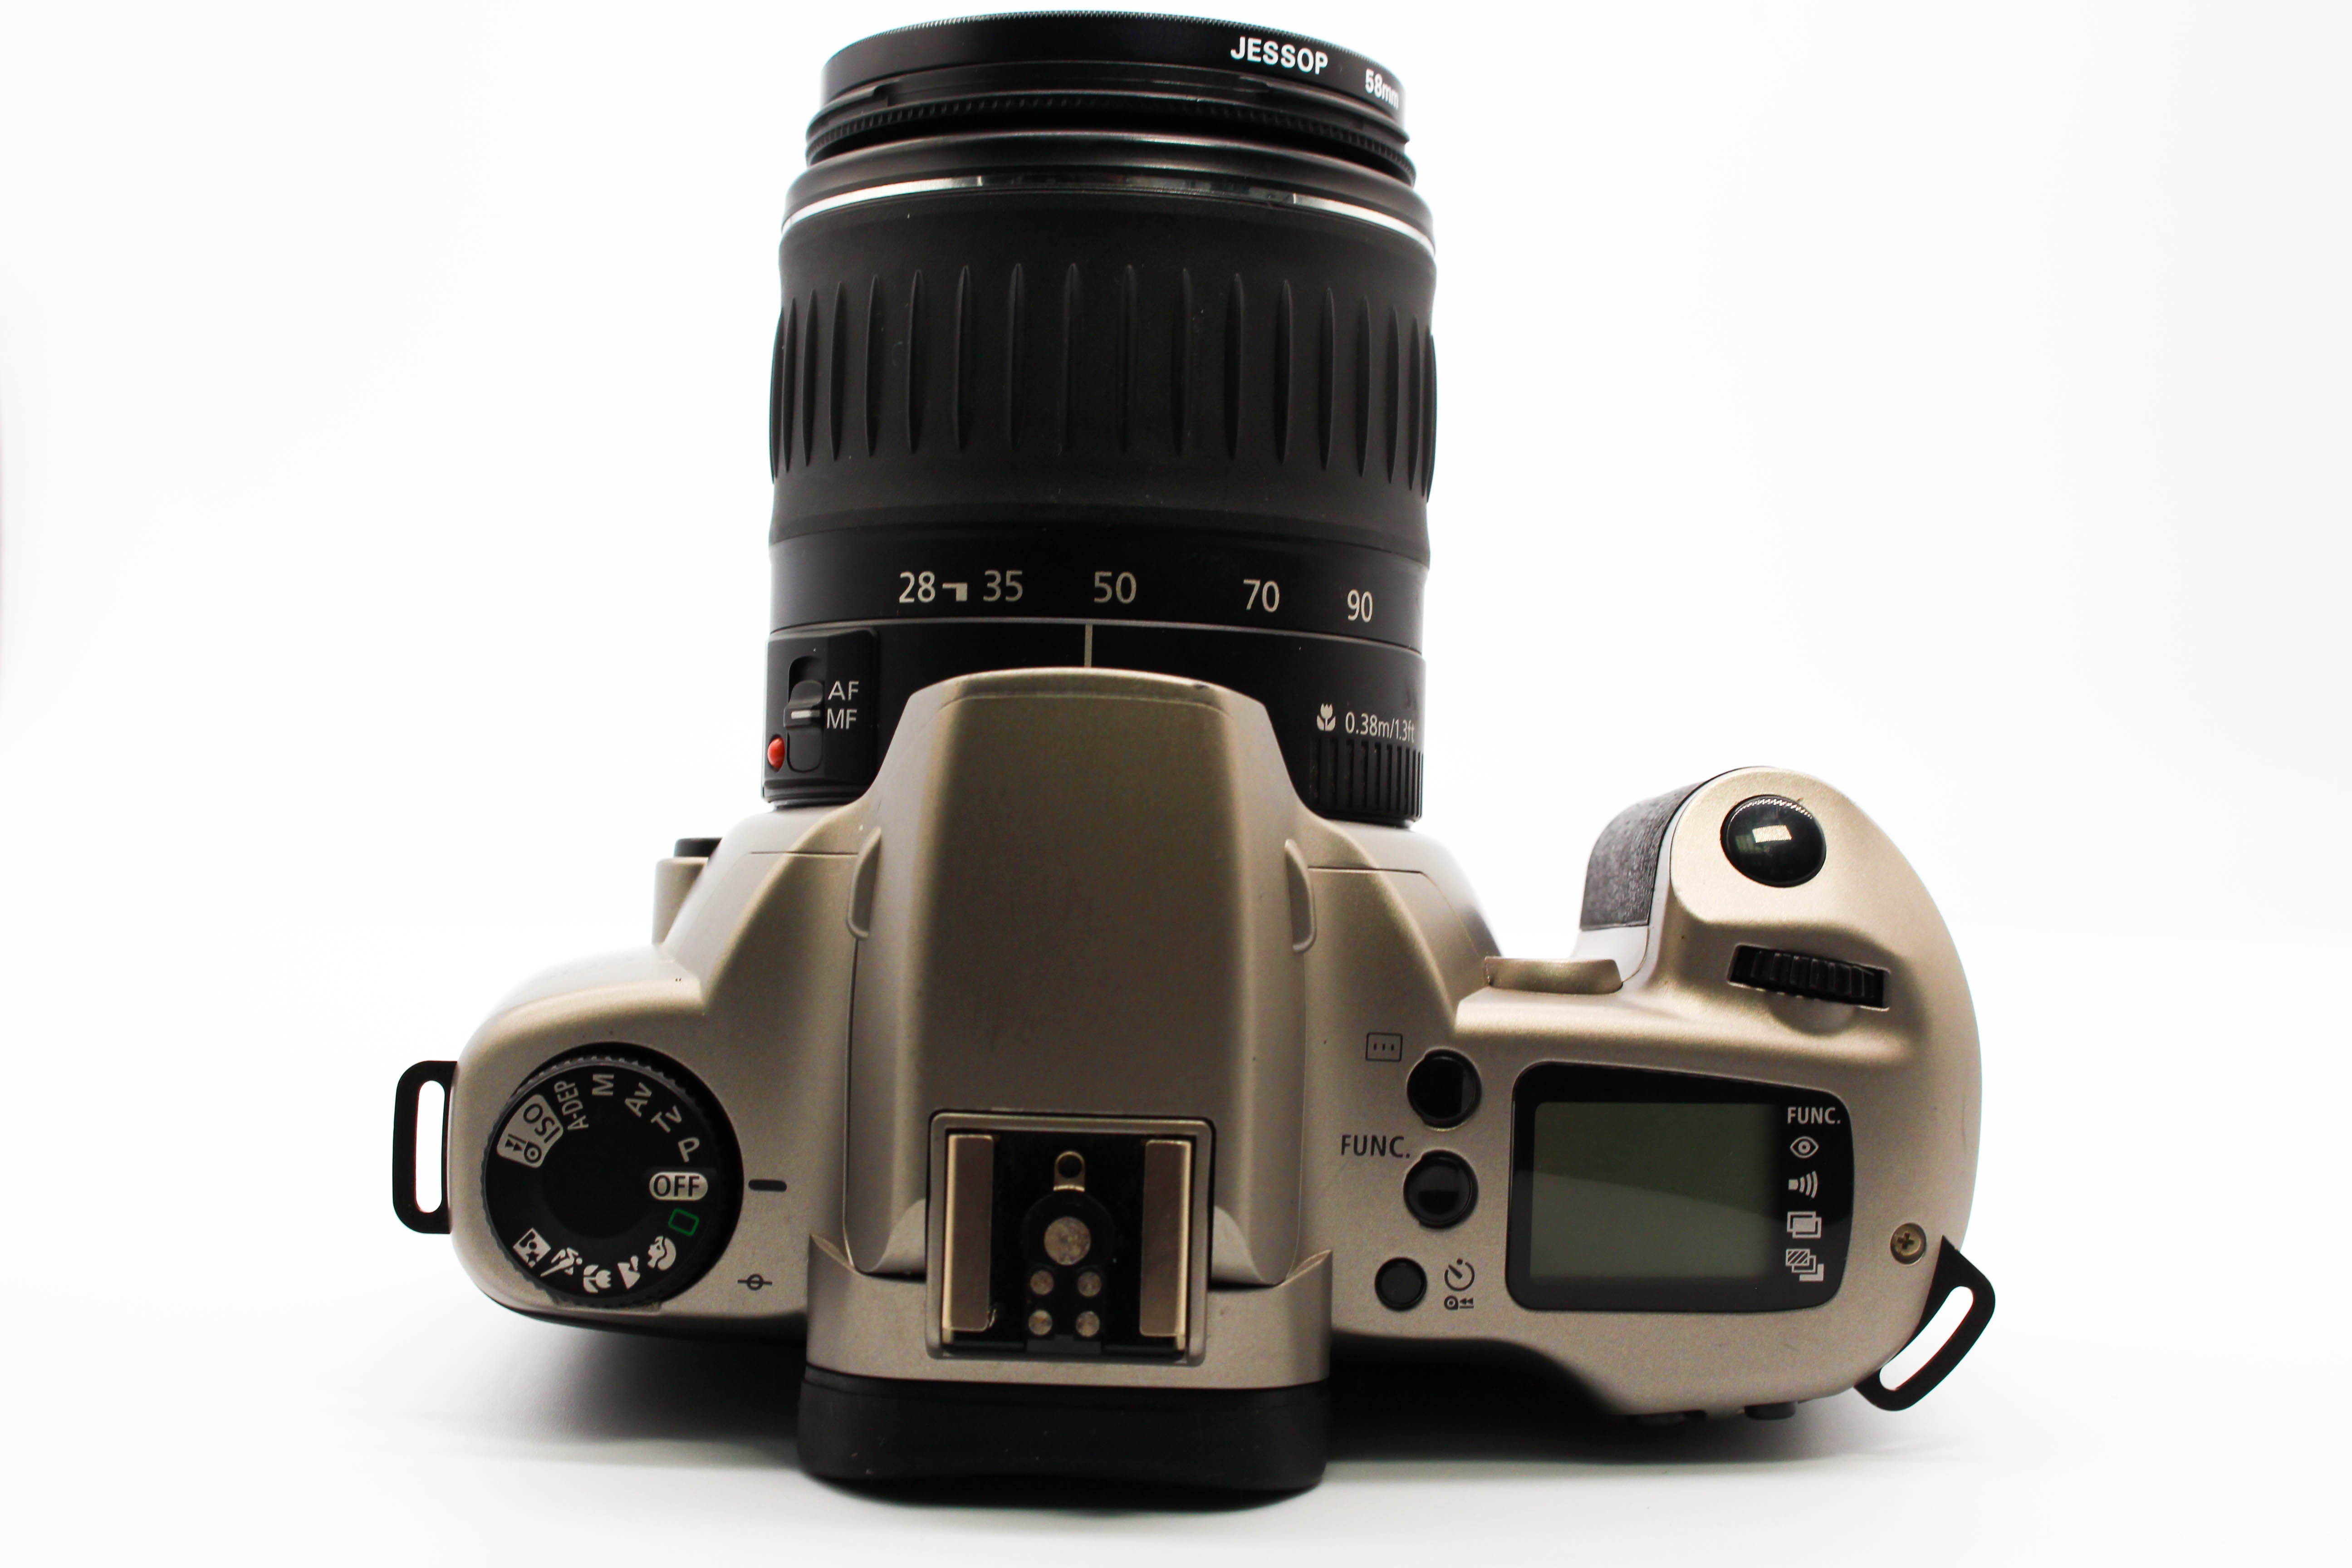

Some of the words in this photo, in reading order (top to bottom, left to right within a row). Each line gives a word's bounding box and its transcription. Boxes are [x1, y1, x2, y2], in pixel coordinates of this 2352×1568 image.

[1230, 36, 1328, 75] JESSOP
[1365, 69, 1399, 109] 58mm
[983, 570, 1023, 602] 35
[1093, 571, 1136, 604] 50
[1244, 579, 1279, 612] 70
[1347, 589, 1373, 622] 90
[828, 681, 859, 701] AF
[826, 708, 857, 730] MF
[592, 1074, 614, 1096] M
[554, 1080, 588, 1131] A-DEP
[1788, 1106, 1841, 1124] FUNC.
[523, 1103, 560, 1143] ISO
[651, 1105, 681, 1132] Tv
[678, 1137, 700, 1162] P
[1341, 1135, 1410, 1158] FUNC.
[653, 1175, 700, 1197] OFF
